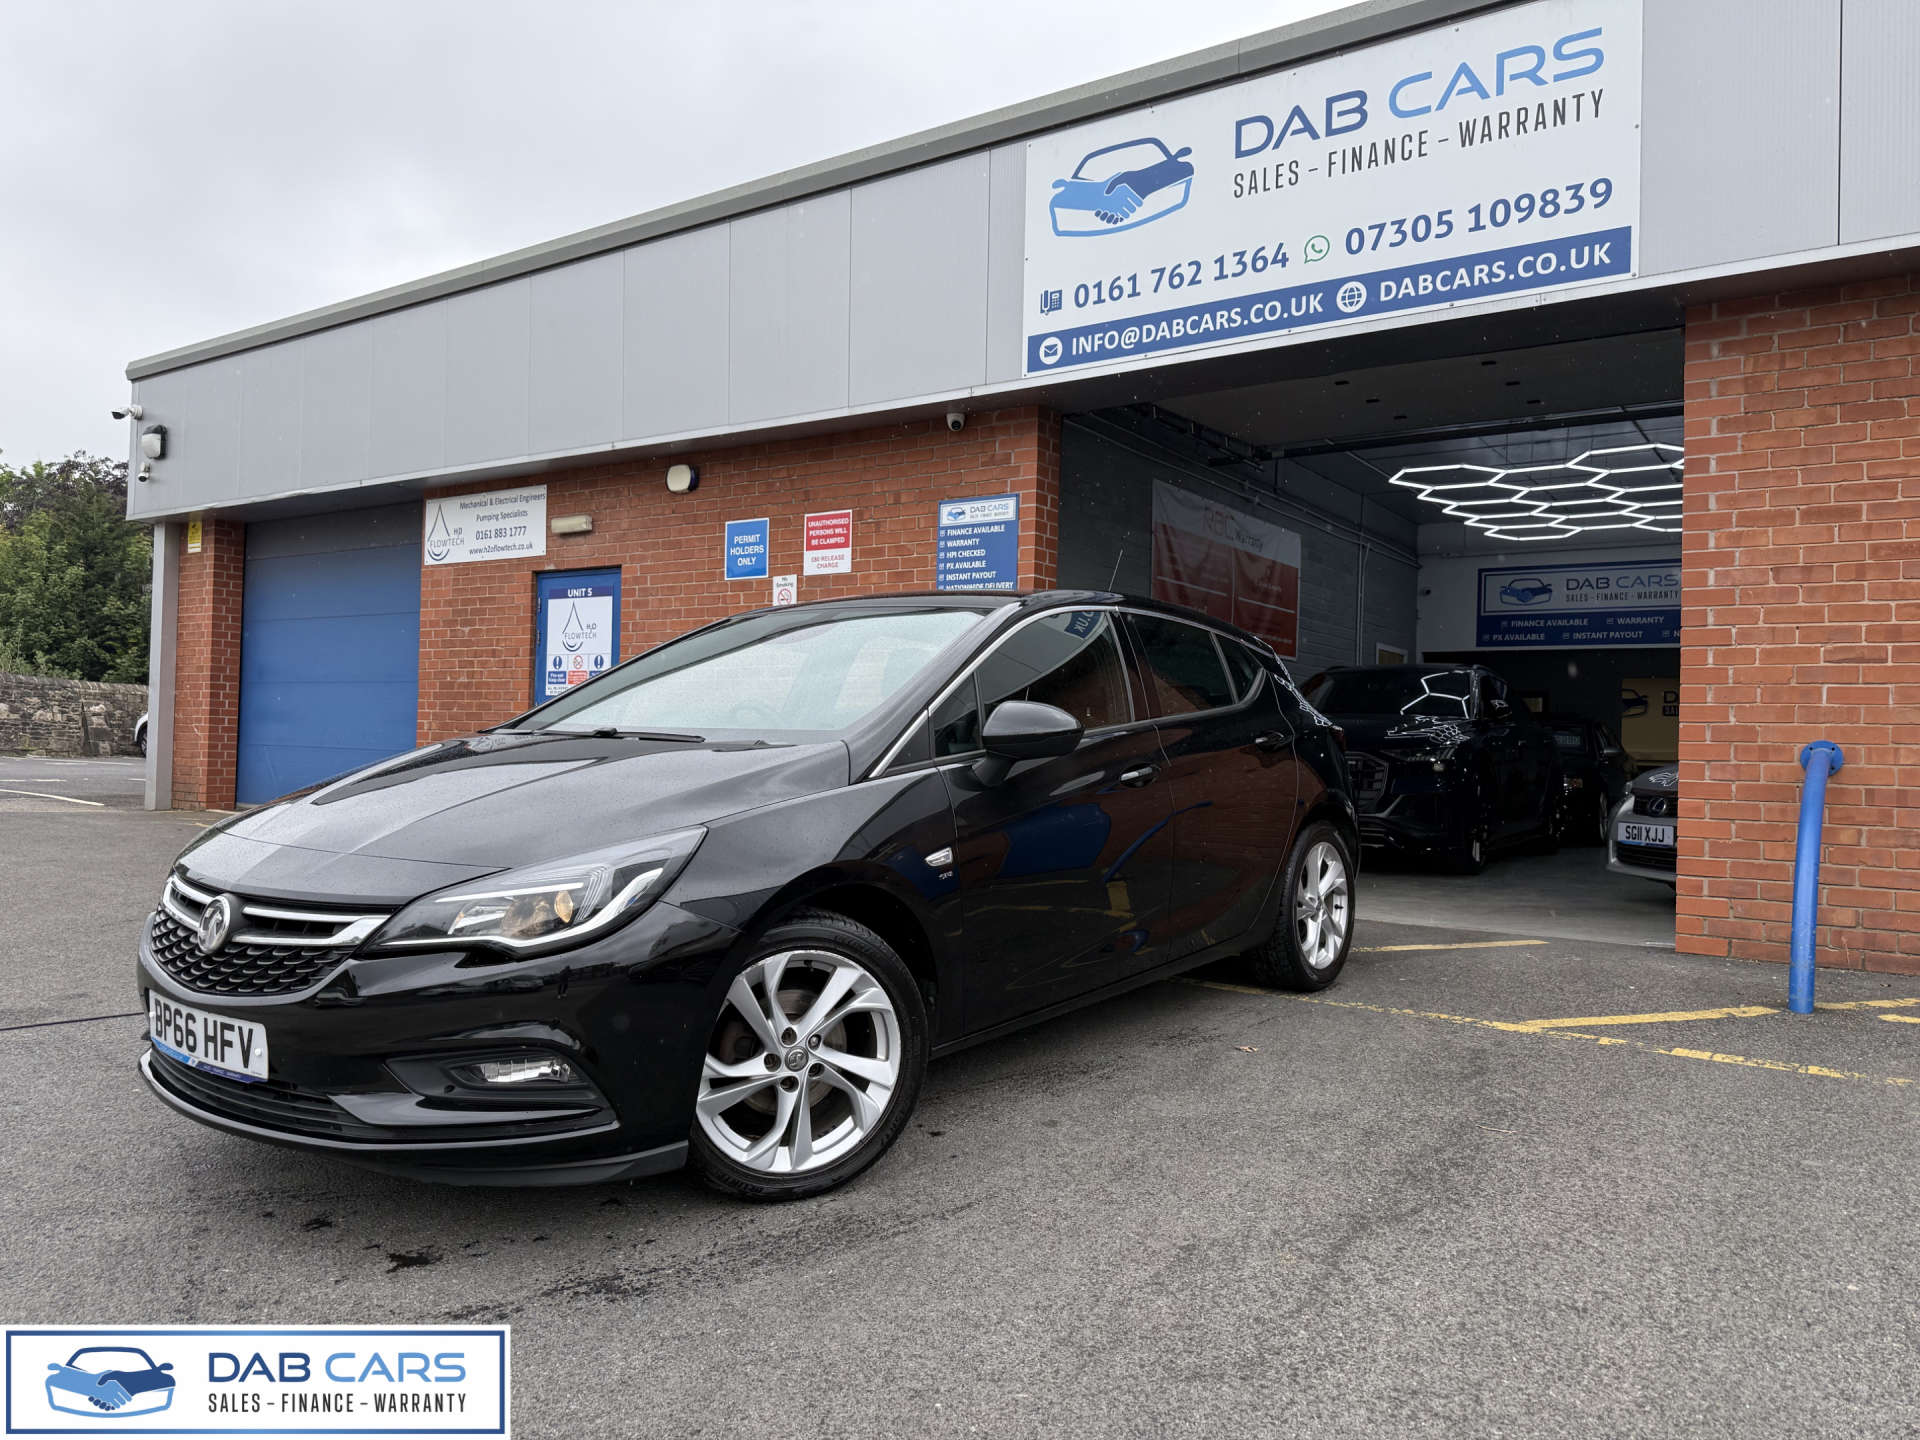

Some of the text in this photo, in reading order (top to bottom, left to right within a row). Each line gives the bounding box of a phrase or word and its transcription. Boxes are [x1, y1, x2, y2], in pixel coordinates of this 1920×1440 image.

[1234, 27, 1605, 159] DAB CARS
[1233, 160, 1300, 199] SALES
[1327, 130, 1429, 179] FINANCE
[1458, 88, 1605, 148] WARRANTY
[1345, 177, 1614, 255] 07305 109839
[1074, 242, 1290, 309] 0161 762 1364
[1379, 242, 1613, 303] DABCARS.CO.UK
[1071, 292, 1325, 356] INFO@DABCARS.CO.UK
[476, 510, 528, 523] Pumping Specialists
[475, 530, 494, 540] 0161
[509, 526, 527, 538] 1777
[947, 524, 1006, 536] FINANCE AVAILABLE
[429, 538, 465, 548] FLOWTECH
[734, 534, 760, 545] PERMIT
[820, 536, 845, 544] CLAMPED
[947, 538, 980, 548] WARRANTY
[469, 541, 533, 555] www.h2oflowtech.co.uk
[730, 544, 764, 556] HOLDERS
[958, 549, 986, 558] CHECKED
[737, 556, 757, 566] ONLY
[955, 560, 986, 569] AVAILABLE
[946, 571, 996, 581] INSTANT PAYOUT
[1566, 574, 1679, 591] DAB CARS
[568, 588, 592, 597] UNIT 5
[1511, 618, 1589, 628] FINANCE AVAILABLE
[1617, 616, 1664, 625] WARRANTY
[564, 632, 597, 640] FLOWTECH
[1504, 632, 1545, 641] AVAILABLE
[1573, 631, 1644, 640] INSTANT PAYOUT
[1644, 826, 1665, 842] XJJ
[154, 998, 197, 1053] BP66
[204, 1017, 254, 1069] HFV
